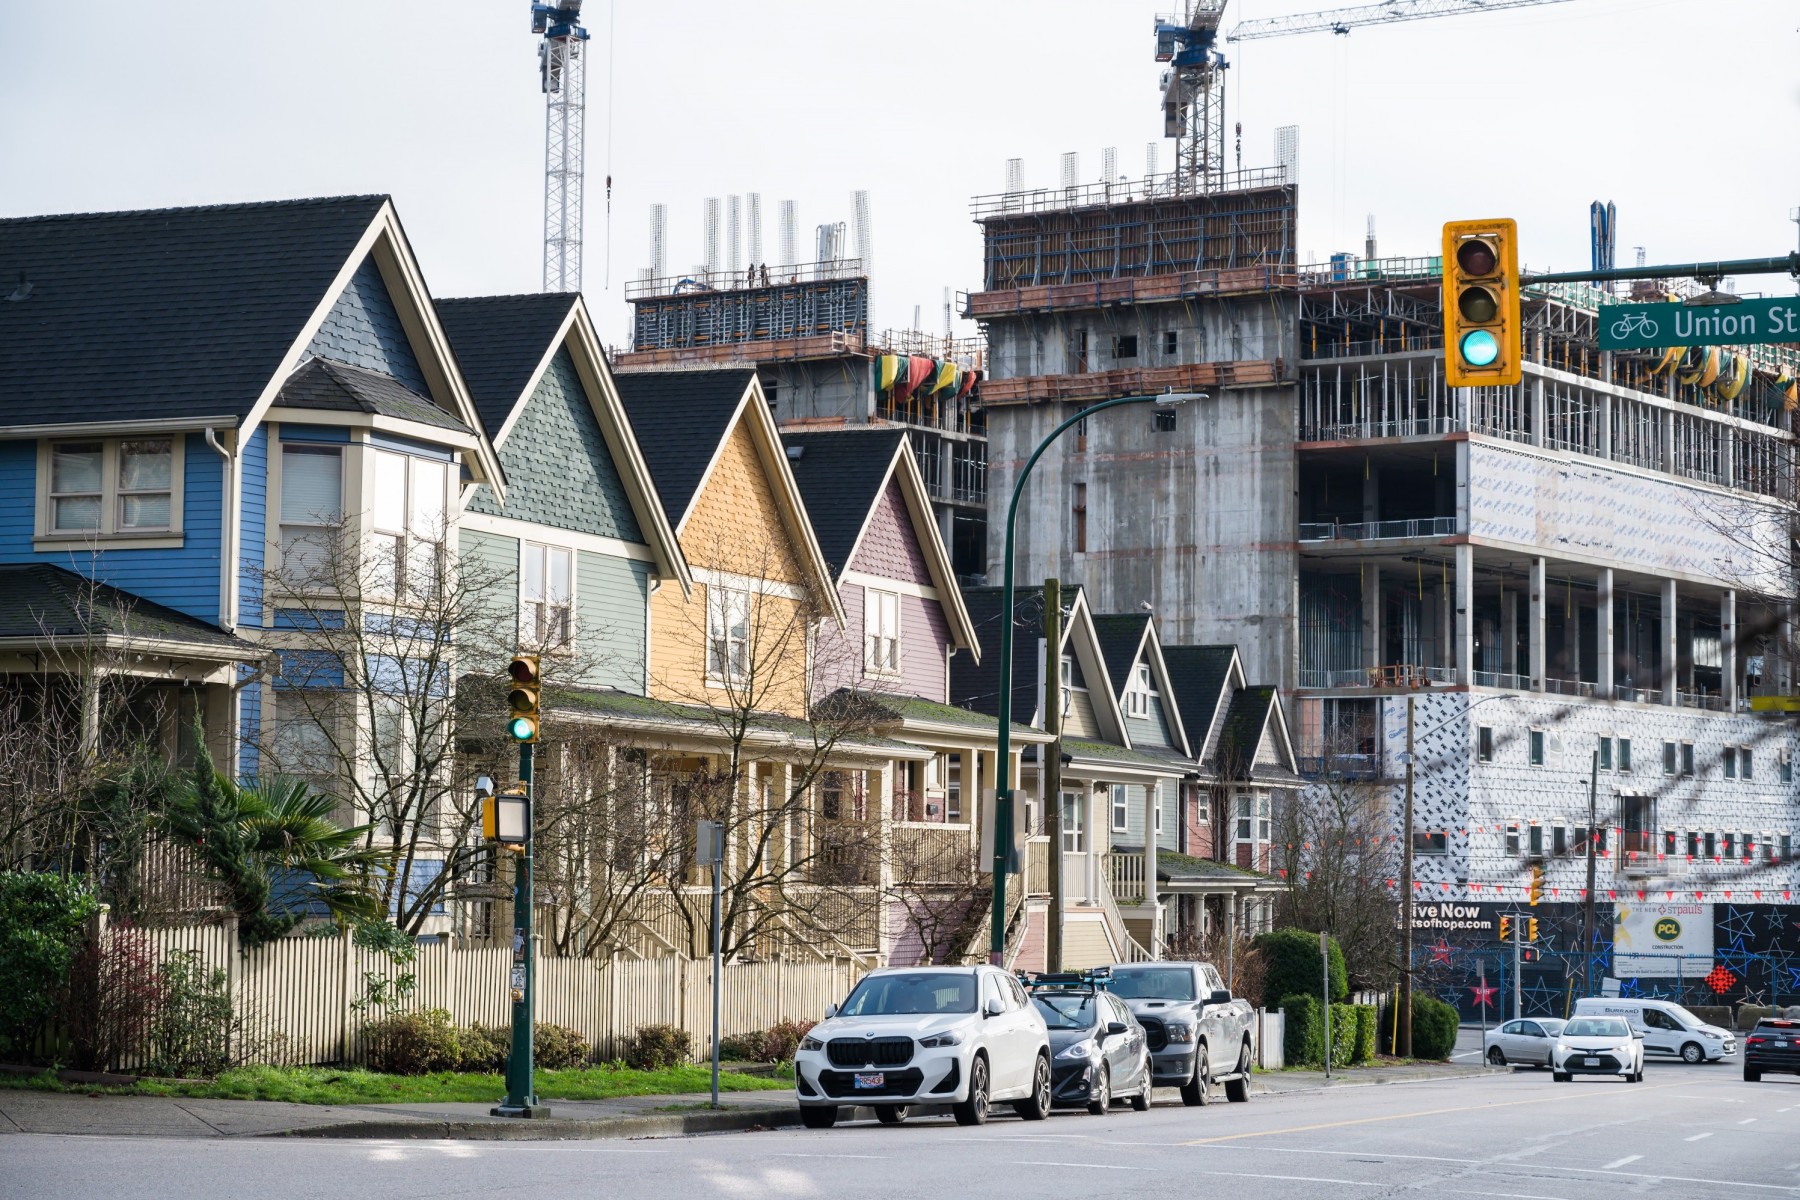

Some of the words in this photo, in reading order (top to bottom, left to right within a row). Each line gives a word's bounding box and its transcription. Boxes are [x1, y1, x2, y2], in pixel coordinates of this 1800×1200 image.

[1675, 308, 1756, 338] Union
[1767, 306, 1800, 334] St
[1398, 903, 1438, 918] ive
[1441, 903, 1480, 918] Now
[1393, 918, 1492, 930] tsofhope.com
[1657, 923, 1678, 934] PCL
